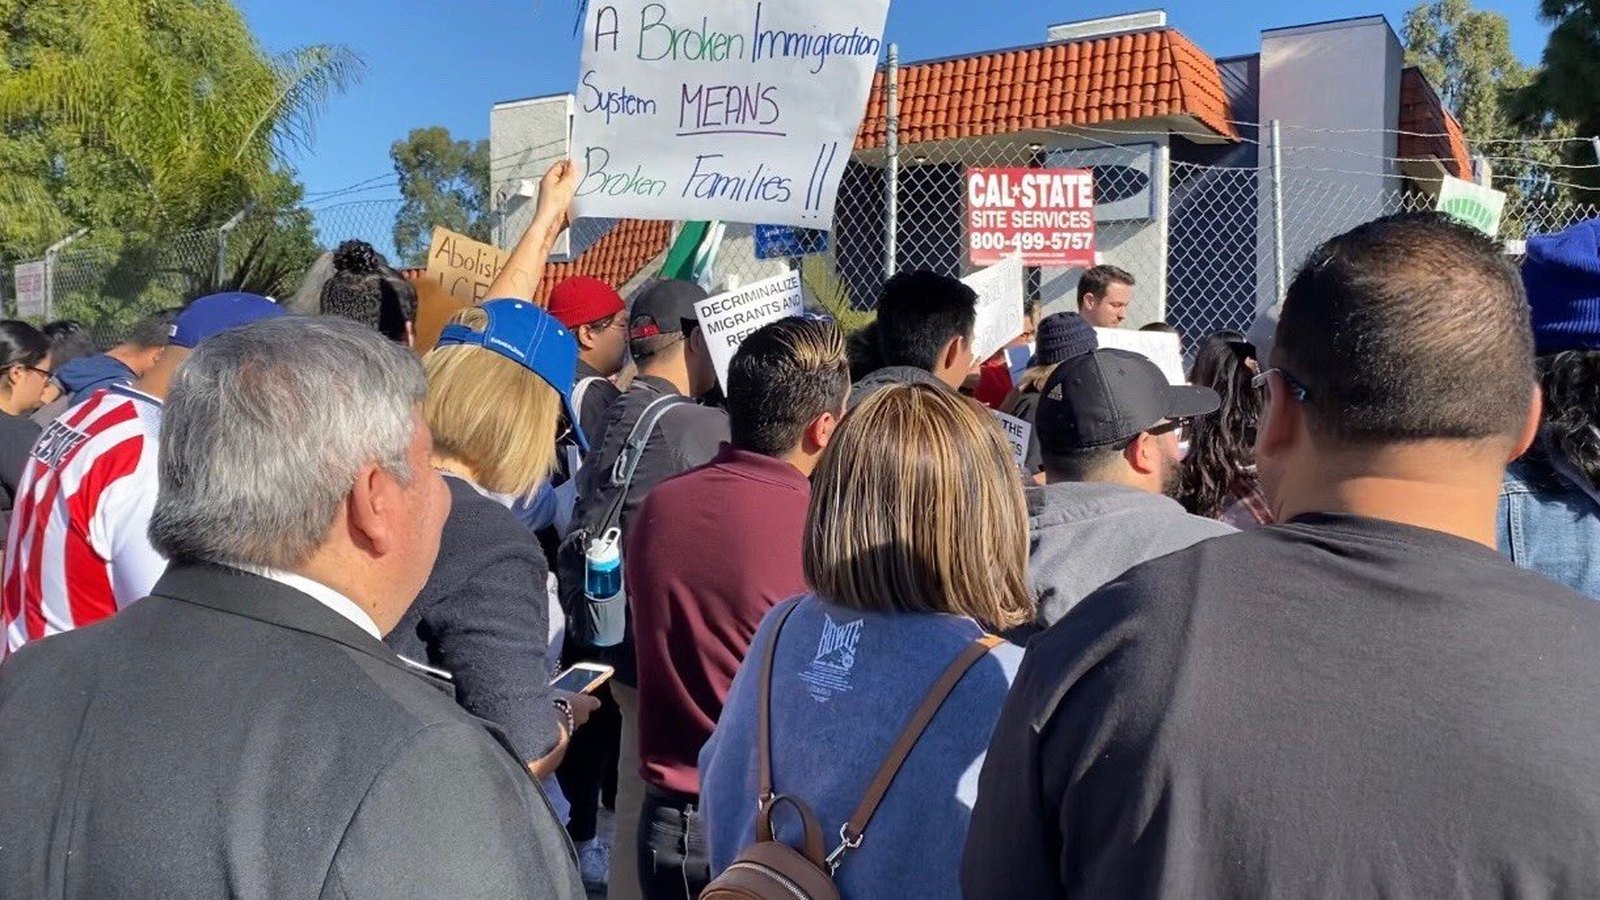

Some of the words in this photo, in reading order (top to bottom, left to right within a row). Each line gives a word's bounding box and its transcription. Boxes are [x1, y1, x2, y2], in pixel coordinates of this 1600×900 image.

[594, 6, 619, 52] A
[637, 3, 744, 62] Broken
[751, 2, 880, 74] Immigration
[582, 70, 656, 125] System
[678, 82, 780, 129] MEANS
[574, 146, 667, 198] Broken
[681, 154, 791, 203] Families
[1021, 173, 1094, 209] STATE
[971, 210, 1007, 229] SITE
[1011, 210, 1092, 229] SERVICES
[970, 231, 1094, 250] 800-499-5757
[701, 276, 799, 318] DECRIMINALIZE
[707, 301, 781, 335] MIGRANTS
[782, 294, 801, 309] AND
[1002, 419, 1024, 439] THE
